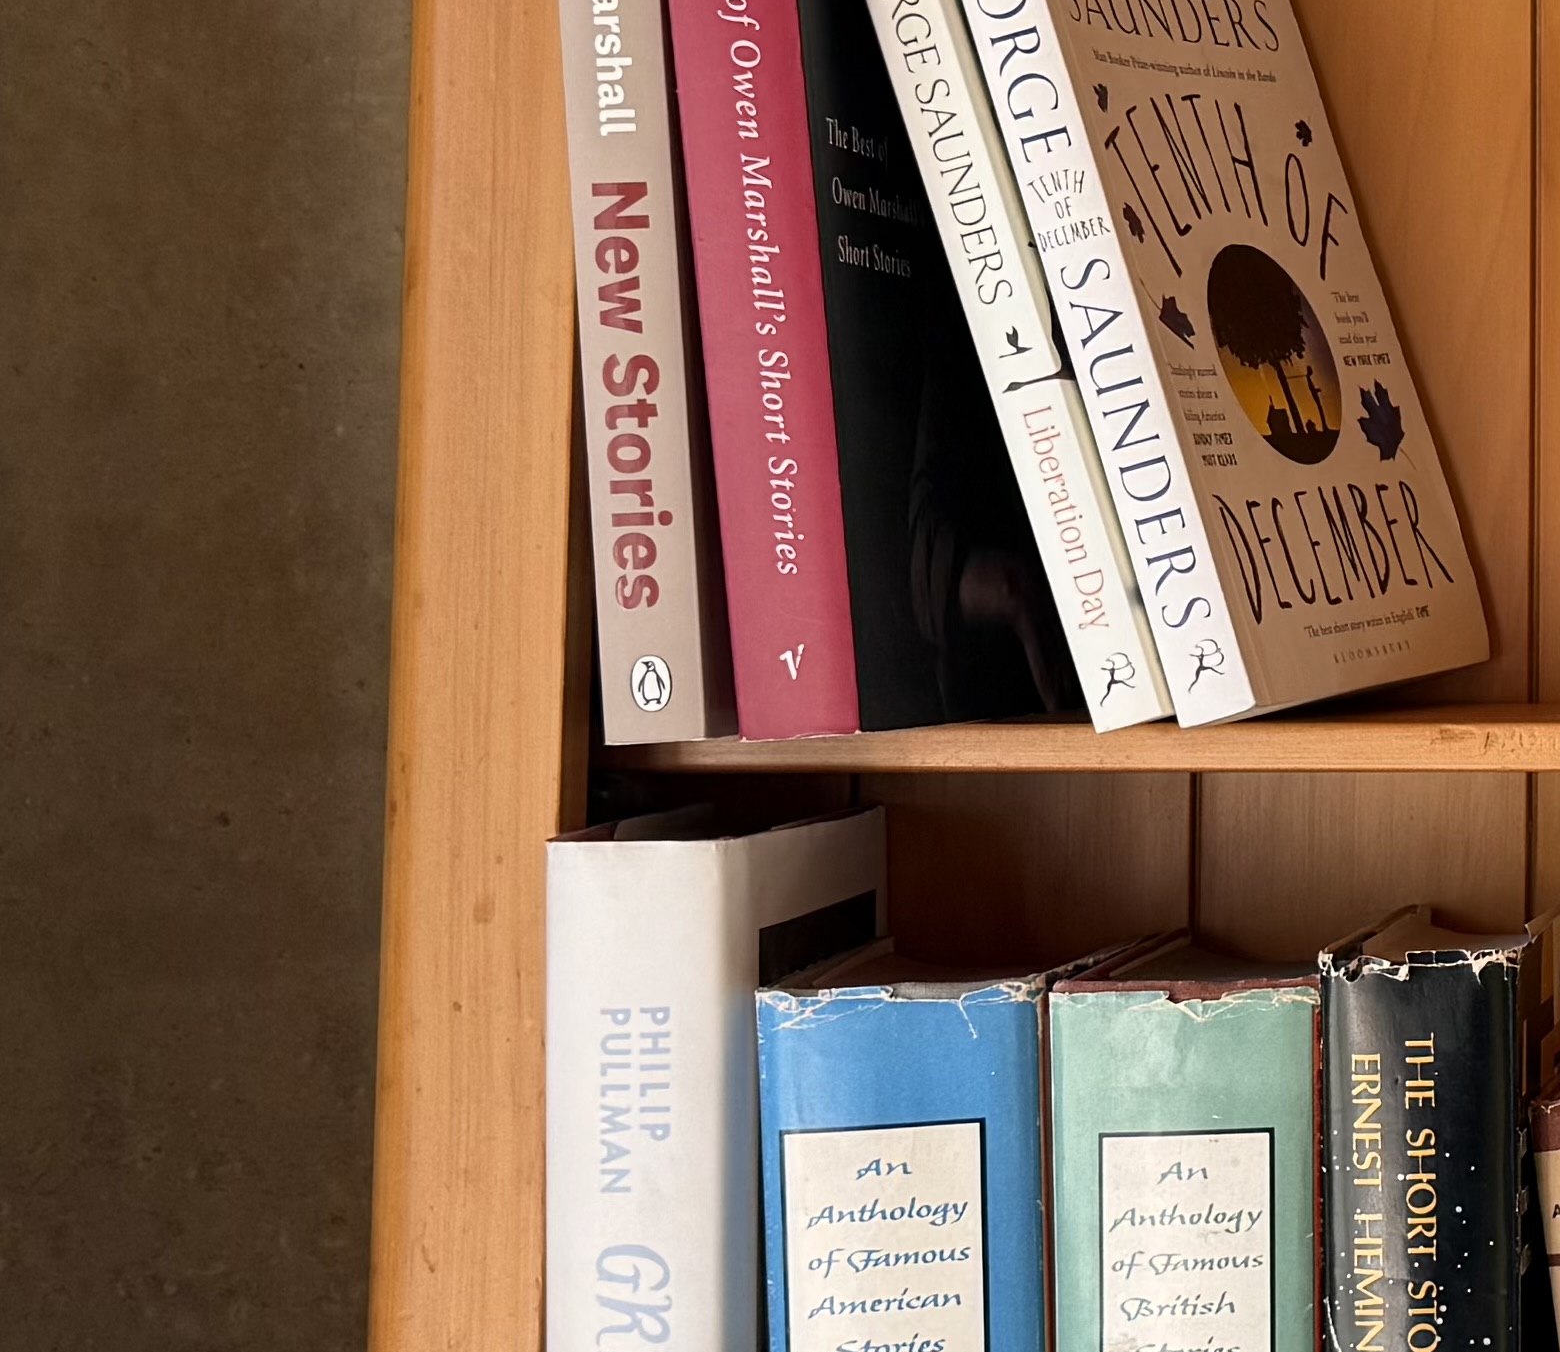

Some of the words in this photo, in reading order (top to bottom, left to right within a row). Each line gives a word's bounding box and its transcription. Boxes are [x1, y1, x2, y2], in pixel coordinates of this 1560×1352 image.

[731, 40, 761, 139] Owen
[826, 117, 848, 149] The
[851, 126, 875, 158] Best
[832, 176, 866, 210] Owen
[914, 82, 1013, 305] SAUNDERS
[1026, 168, 1086, 205] TENTH
[1056, 196, 1073, 219] OF
[1104, 93, 1268, 277] TENTH
[1284, 153, 1349, 281] OF
[591, 180, 651, 334] New
[740, 152, 785, 335] Marshall's
[837, 235, 870, 269] Short
[872, 244, 912, 278] Stories
[1037, 215, 1111, 254] DECEMBER
[758, 348, 791, 445] Short
[602, 354, 675, 611] Stories
[1060, 257, 1213, 629] SAUNDERS
[767, 455, 806, 576] Stories
[1022, 404, 1090, 565] Liberation
[1072, 567, 1110, 630] Day
[1212, 479, 1454, 624] DECEMBER
[599, 1008, 633, 1194] PULLMAN
[638, 1005, 672, 1142] PHILIP
[1403, 1031, 1435, 1110] THE
[1351, 1053, 1383, 1190] ERNEST
[856, 1157, 912, 1180] An
[1157, 1161, 1209, 1185] An
[1405, 1128, 1438, 1262] SHORT
[806, 1197, 968, 1229] Anthology
[1109, 1203, 1263, 1234] Anthology
[808, 1248, 842, 1279] of
[846, 1243, 971, 1270] Famous
[809, 1289, 962, 1319] American
[1111, 1250, 1145, 1280] of
[1149, 1253, 1264, 1276] Famous
[1120, 1290, 1236, 1322] British
